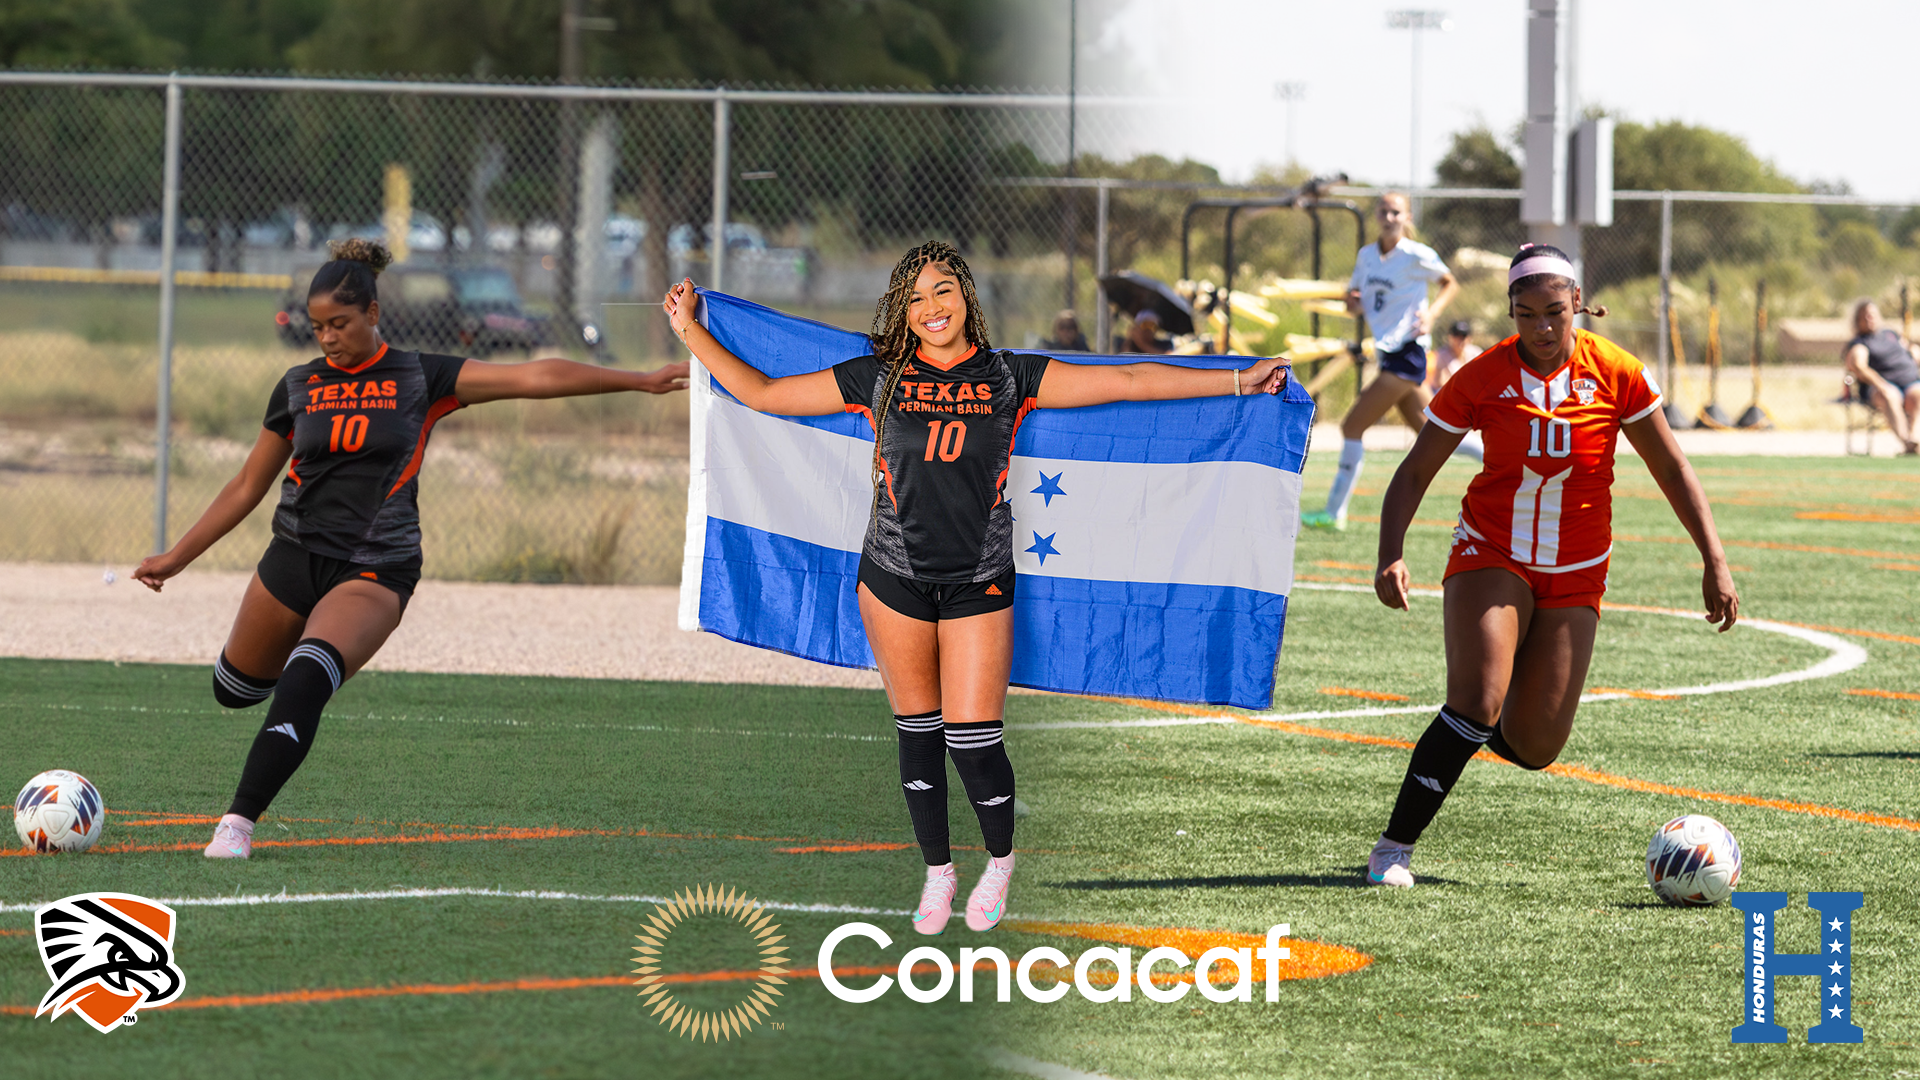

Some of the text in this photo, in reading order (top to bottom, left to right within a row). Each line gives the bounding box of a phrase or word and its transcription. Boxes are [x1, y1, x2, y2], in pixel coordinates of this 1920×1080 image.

[308, 380, 397, 404] TEXAS
[901, 381, 993, 402] TEXAS
[305, 399, 397, 415] PERMIAN BASIN
[898, 402, 993, 415] PERMIAN BASIN
[329, 414, 370, 453] 10
[924, 420, 967, 463] 10
[1527, 417, 1571, 458] 10
